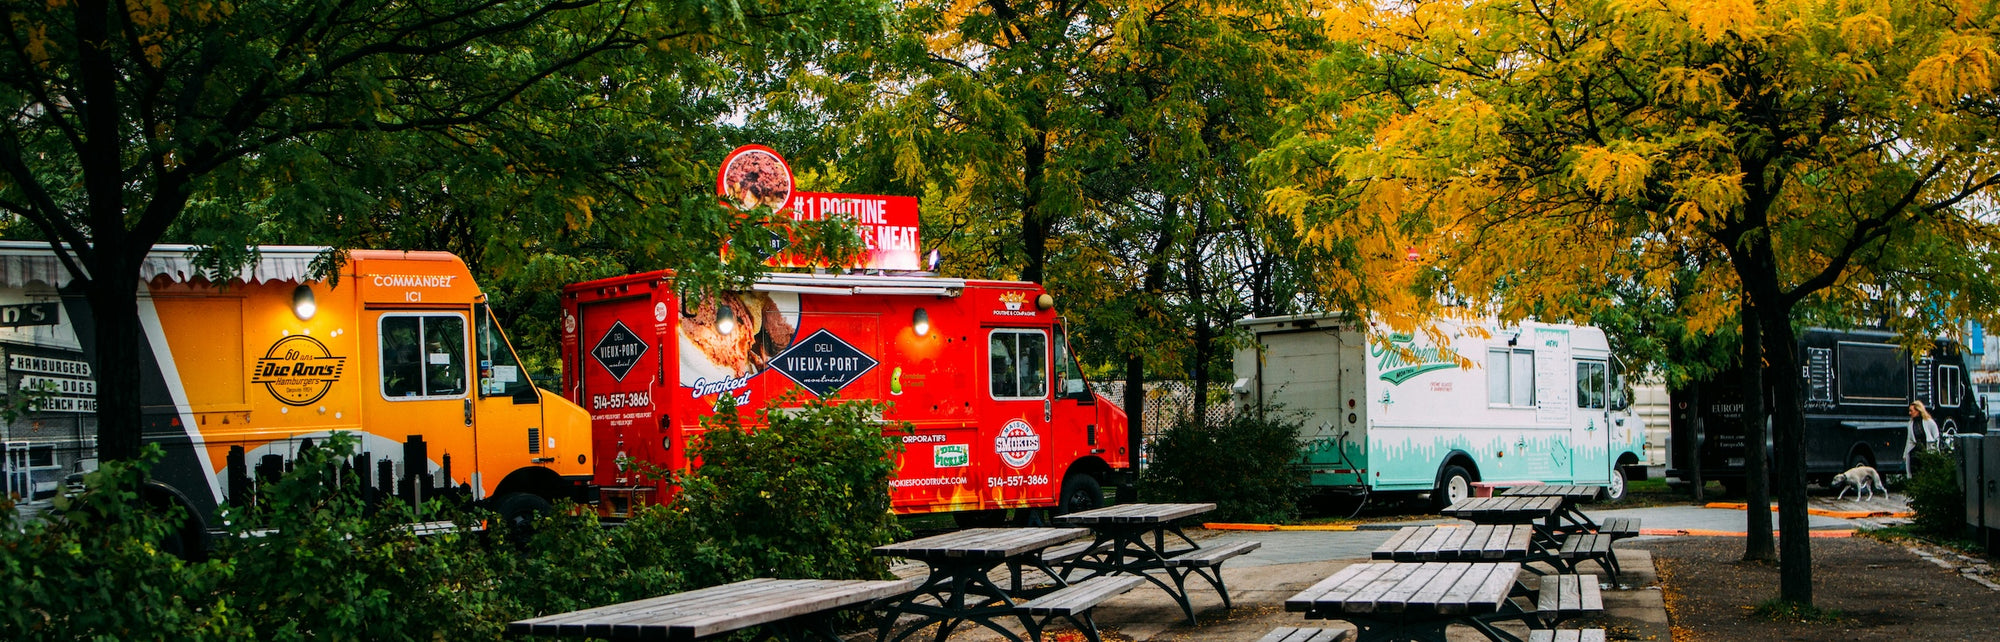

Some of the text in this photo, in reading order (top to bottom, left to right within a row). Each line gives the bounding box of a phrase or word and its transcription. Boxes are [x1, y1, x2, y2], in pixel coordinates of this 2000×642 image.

[820, 197, 887, 224] POUTINE
[878, 227, 918, 252] MEAT
[374, 276, 451, 288] COMMANDEZ
[405, 291, 421, 302] ICI
[600, 343, 638, 359] VIEUX-PORT
[814, 343, 833, 353] DELI
[285, 349, 300, 361] 60
[17, 356, 88, 375] HAMBURGERS
[291, 362, 335, 377] Ann's
[787, 356, 859, 372] VIEUX-PORT
[276, 378, 321, 387] Hamburgers
[693, 372, 749, 398] Smoked
[803, 374, 846, 383] montréal
[36, 398, 97, 411] RENCH FRIE
[593, 392, 650, 410] 514-557-3866
[1004, 421, 1029, 433] MAISON
[902, 435, 946, 443] ORPORATIFS
[996, 436, 1039, 452] SMOKIES
[940, 445, 962, 454] DILL
[935, 453, 968, 467] PICKLES
[889, 477, 967, 487] MOKIESFOODTRUCK.COM
[988, 475, 1048, 488] 514-557-3866
